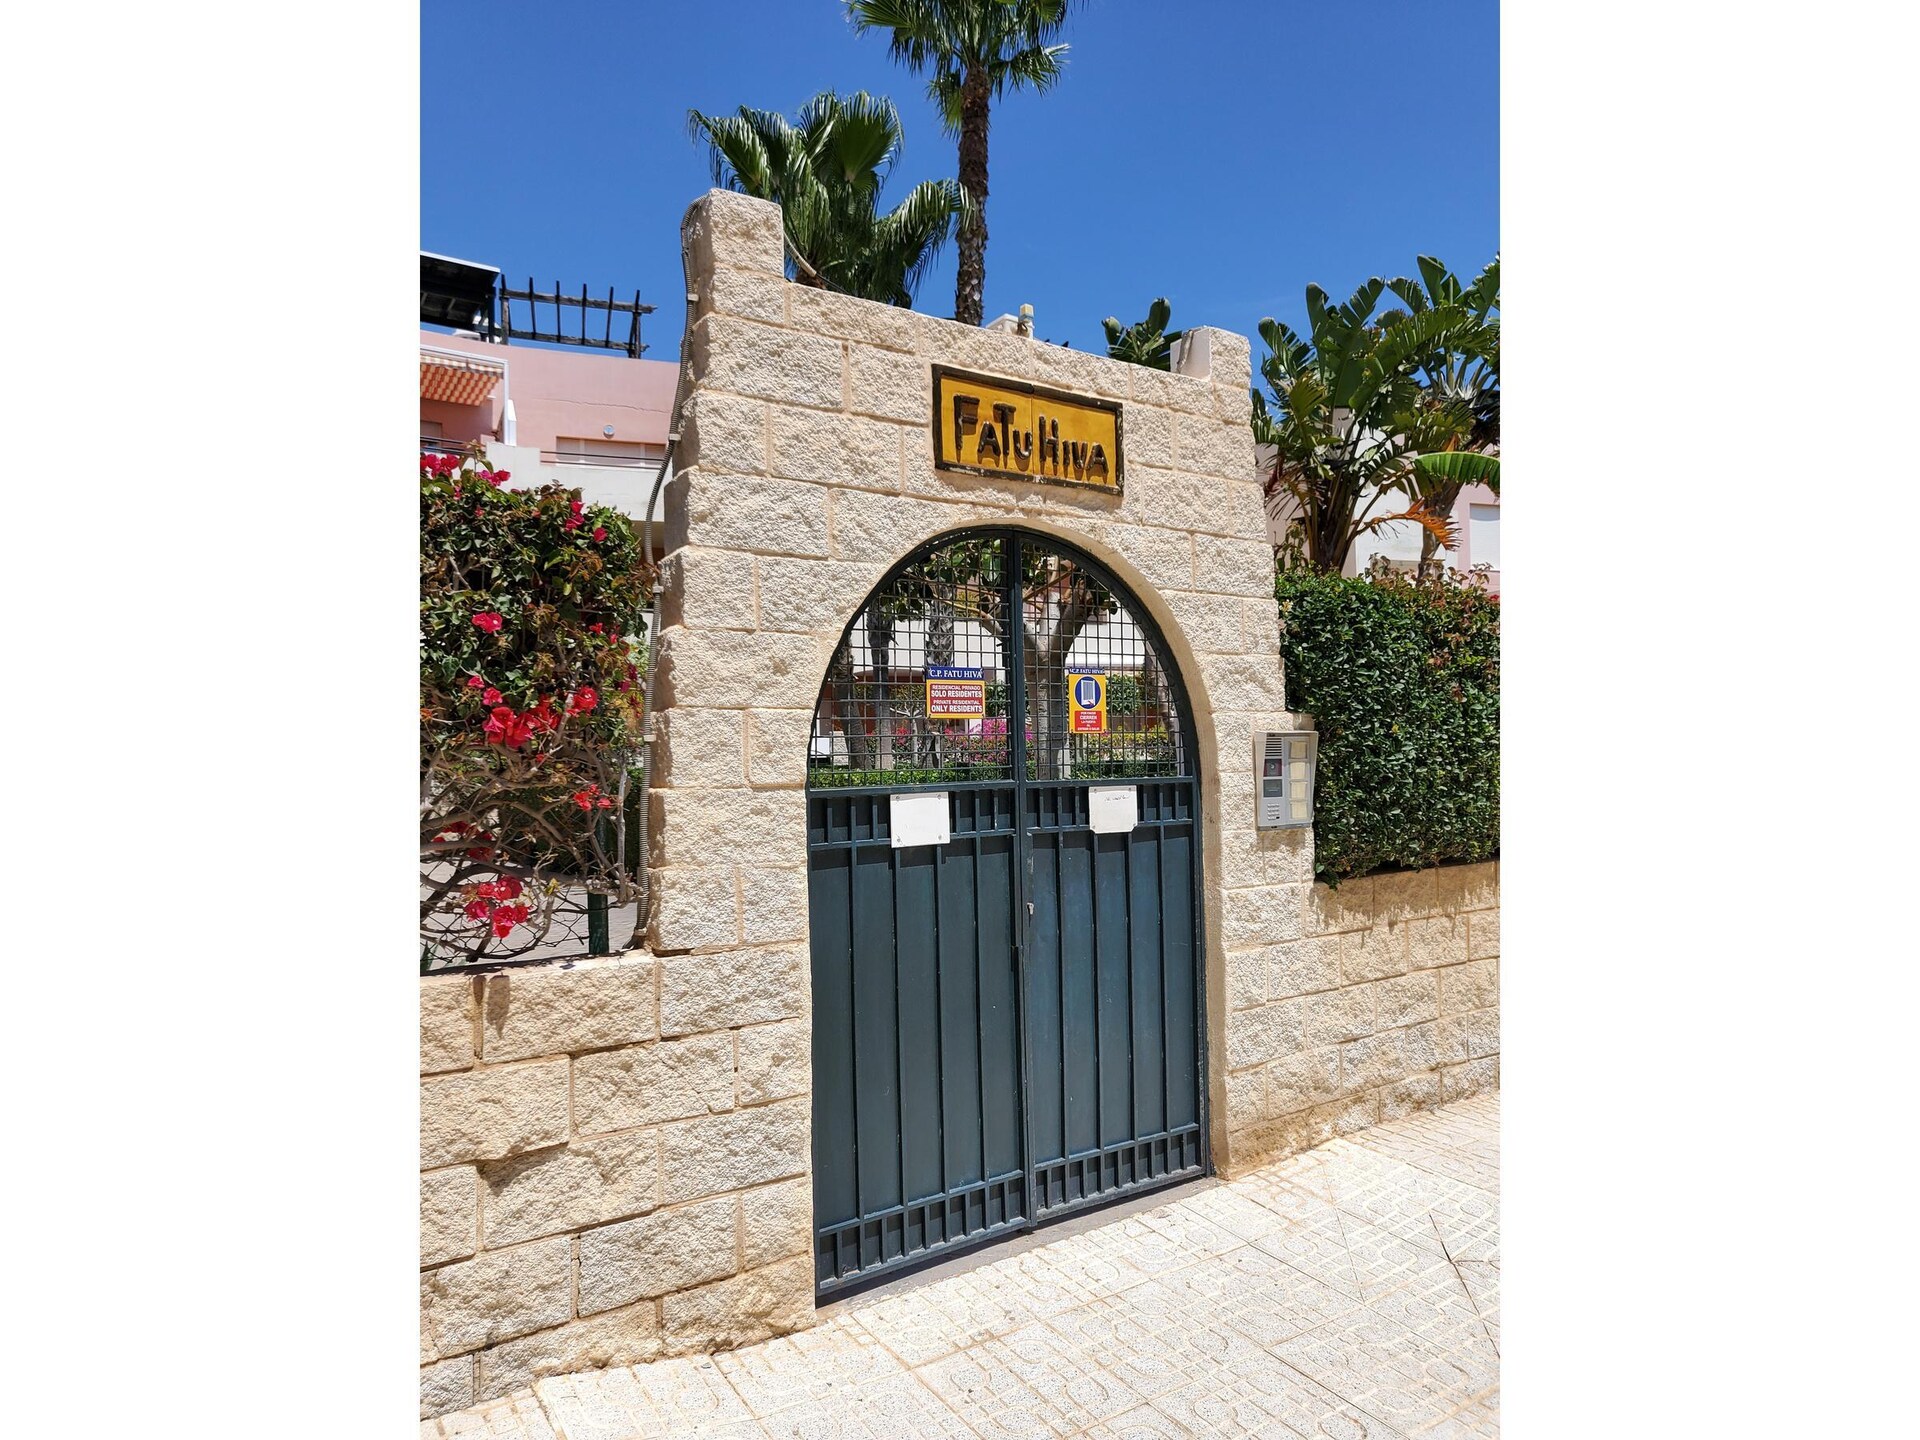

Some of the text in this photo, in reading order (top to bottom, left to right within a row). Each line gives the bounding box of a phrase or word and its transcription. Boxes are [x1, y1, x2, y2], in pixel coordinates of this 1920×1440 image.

[953, 394, 1109, 474] FATU HIVA
[930, 669, 982, 678] C.P. FATU HIVA
[931, 690, 982, 698] SOLO RESIDENTES
[949, 705, 982, 713] RESIDENTS
